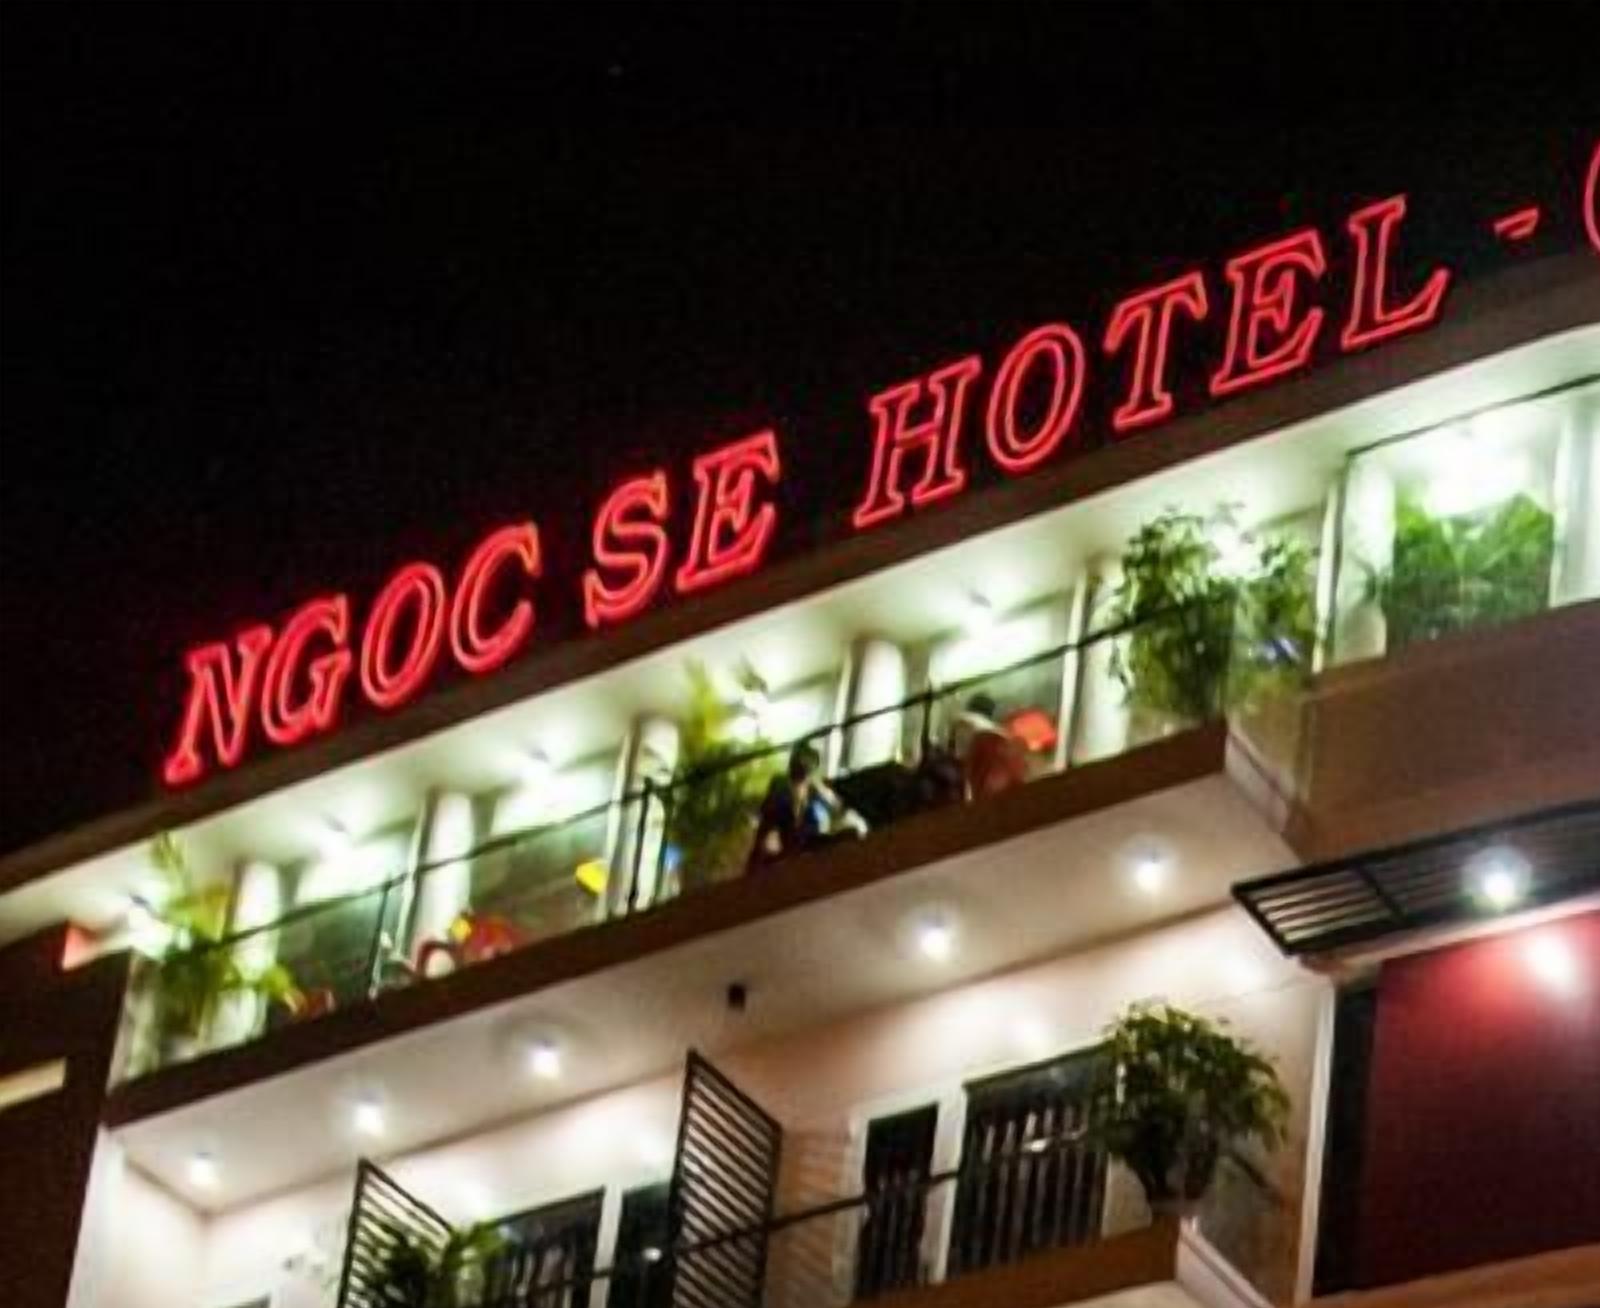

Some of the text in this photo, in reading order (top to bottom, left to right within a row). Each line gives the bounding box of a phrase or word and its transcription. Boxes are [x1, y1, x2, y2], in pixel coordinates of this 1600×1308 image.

[162, 519, 543, 786] NGOC
[583, 428, 781, 628] SE
[851, 192, 1455, 529] HOTEL
